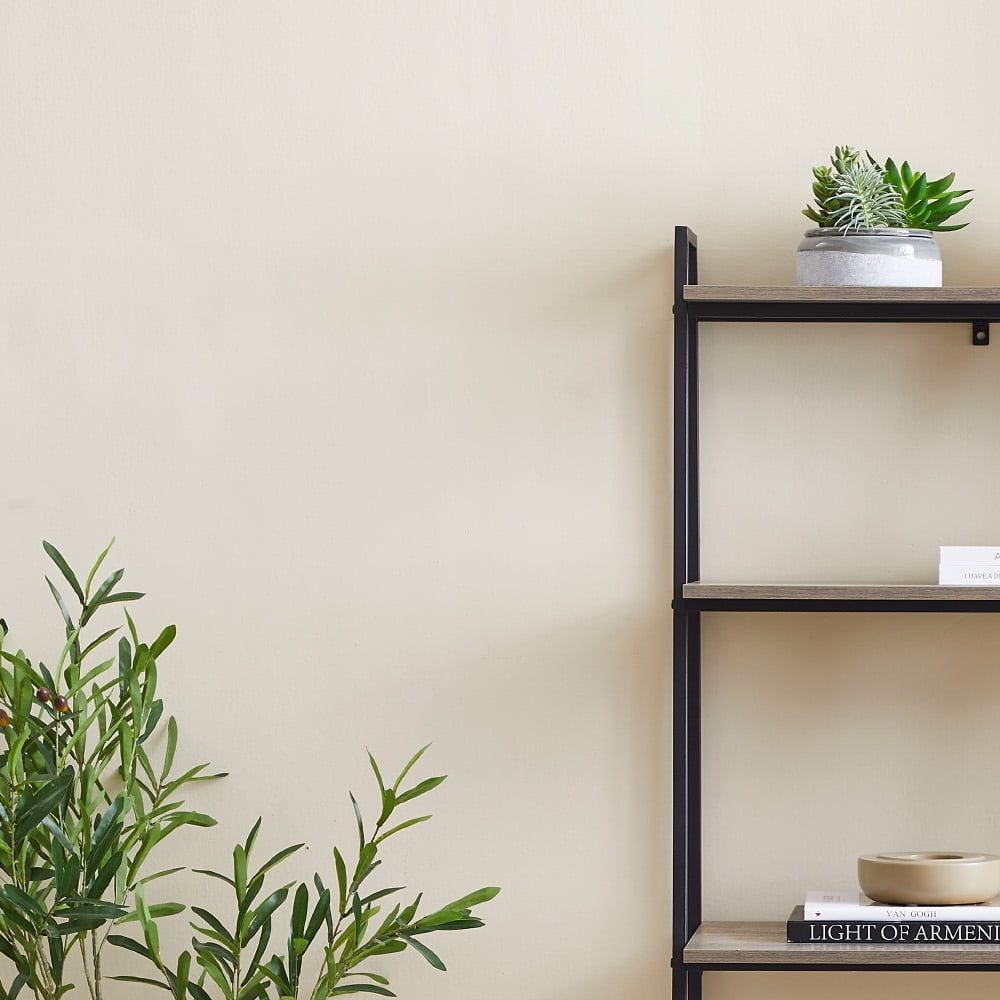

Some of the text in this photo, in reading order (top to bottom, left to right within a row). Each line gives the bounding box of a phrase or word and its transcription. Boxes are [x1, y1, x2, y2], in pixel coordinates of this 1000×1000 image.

[968, 572, 988, 580] HAVE
[886, 910, 937, 918] VAN GOGH
[809, 924, 877, 941] LIGHT
[880, 924, 910, 941] OF
